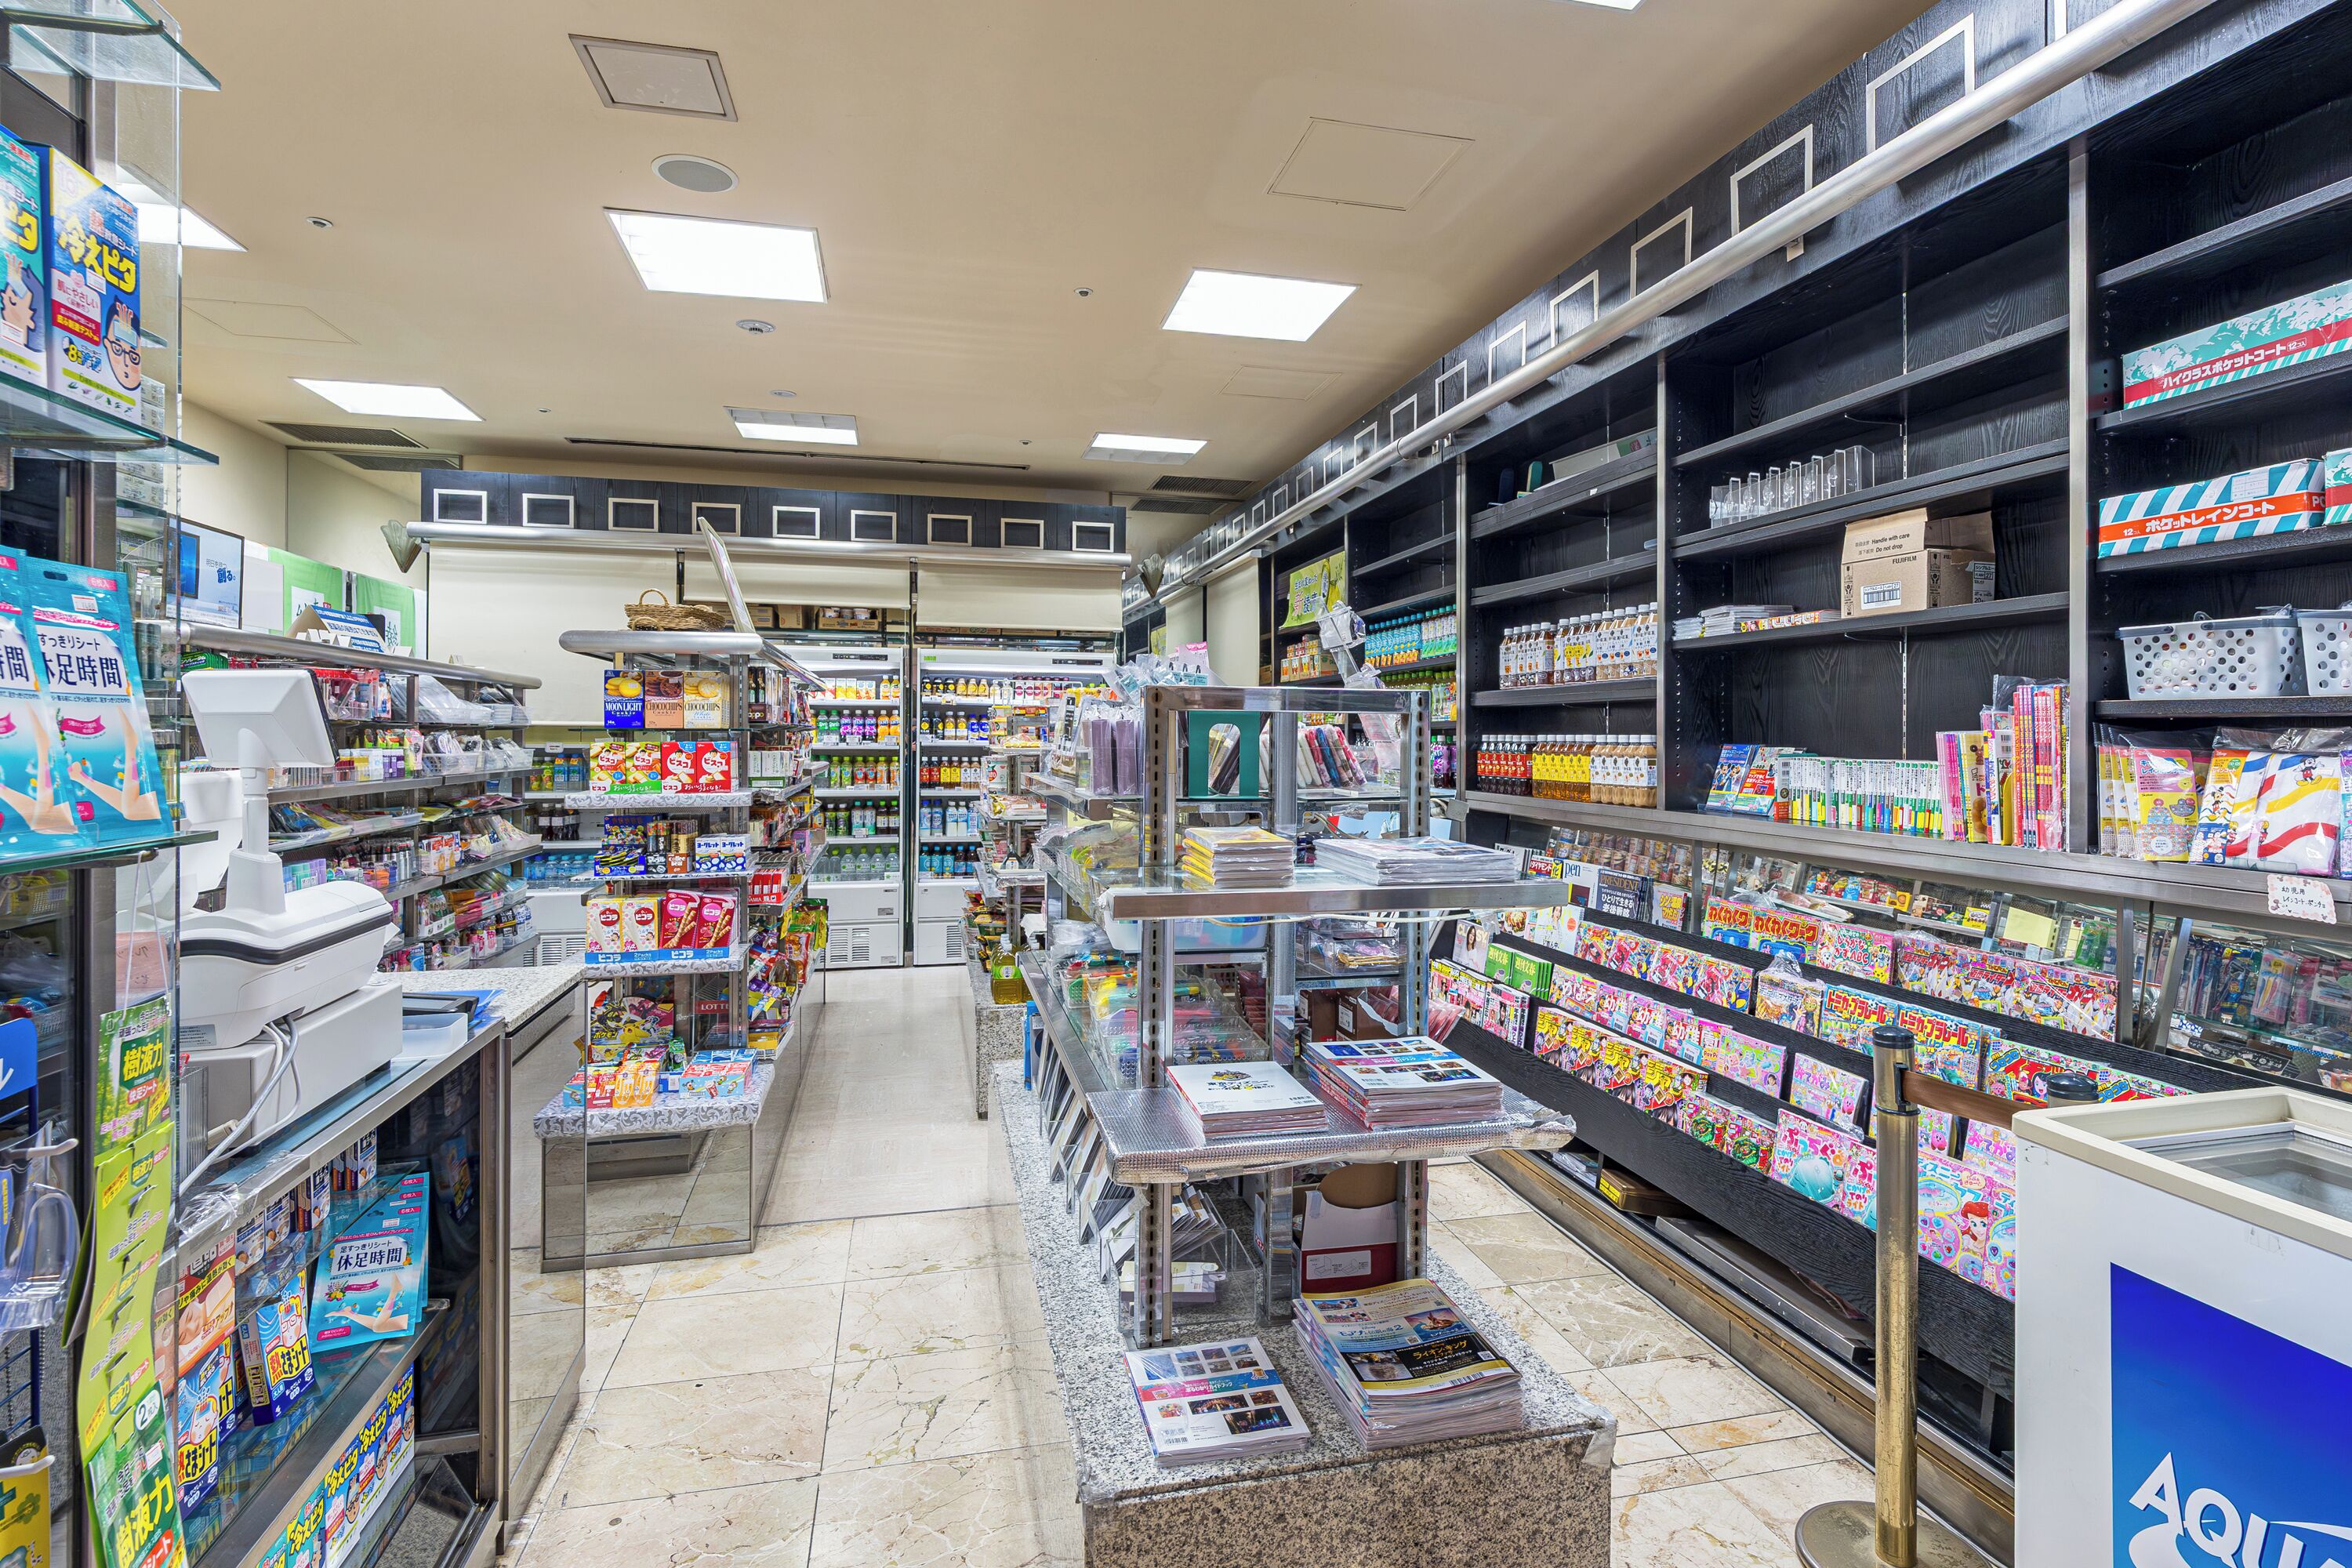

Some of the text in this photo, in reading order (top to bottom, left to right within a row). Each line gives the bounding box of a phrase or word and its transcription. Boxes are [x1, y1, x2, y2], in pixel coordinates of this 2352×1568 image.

[2162, 343, 2286, 389] ハイクラスポケットコート
[2146, 501, 2275, 532] ポケットレインコート
[645, 702, 682, 711] CHOCOCHIPS
[684, 702, 720, 711] CHOCOCHIPS
[599, 757, 617, 765] ビスコ
[669, 757, 689, 768] ビスコ
[704, 757, 724, 768] ビスコ
[1564, 863, 1581, 877] pen
[1601, 875, 1639, 891] PRESIDENT
[2281, 886, 2305, 895] 幼児用
[1602, 894, 1634, 909] ひとりで生きる
[1754, 915, 1819, 942] わくわくワーク
[1837, 936, 1865, 949] ひらがな
[1489, 947, 1508, 966] 週刊文春
[1515, 956, 1536, 976] 週刊文春
[1850, 950, 1869, 963] ABC
[1562, 980, 1599, 1005] めばえ
[1899, 1009, 1969, 1047] トミカ・プラレール
[123, 1038, 163, 1082] 樹液力
[1990, 1051, 2022, 1073] コロコロ
[1779, 1156, 1793, 1167] てのり
[1846, 1182, 1871, 1194] とかげの
[1849, 1193, 1867, 1204] てのり
[339, 1240, 392, 1254] 足すっきりシート
[337, 1247, 404, 1272] 休足時間
[1413, 1340, 1468, 1360] ライオン・キング
[268, 1341, 310, 1385] 熱さまシート
[387, 1374, 412, 1414] 冷えピタ
[359, 1409, 387, 1454] 冷えピタ
[325, 1447, 358, 1498] 冷えピタ
[288, 1497, 324, 1556] 冷えピタ
